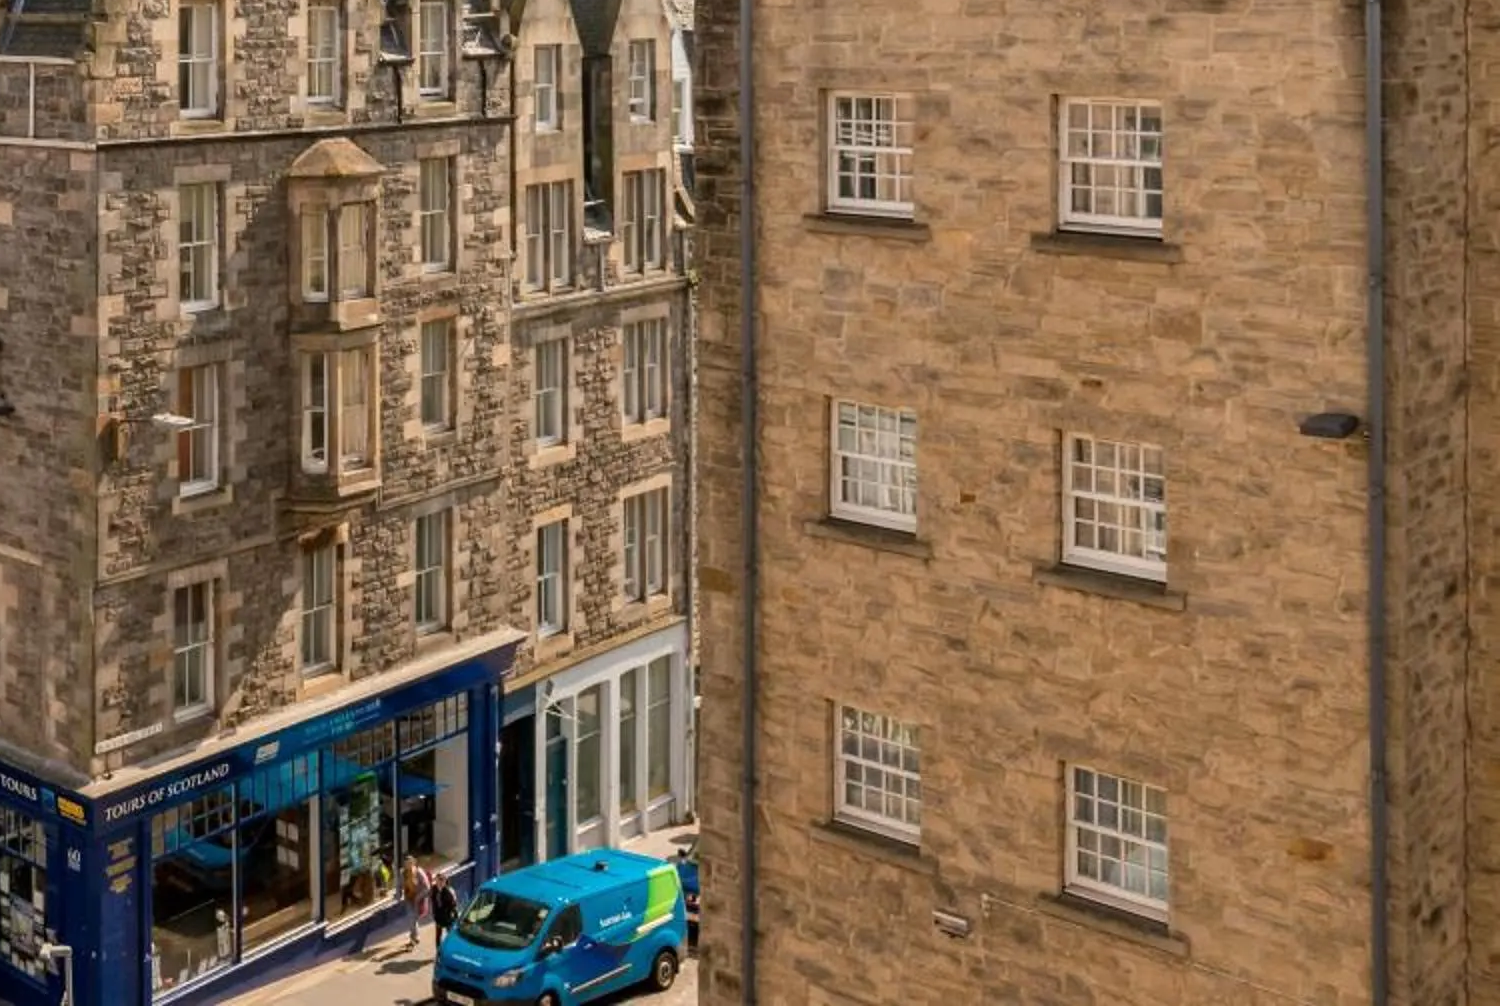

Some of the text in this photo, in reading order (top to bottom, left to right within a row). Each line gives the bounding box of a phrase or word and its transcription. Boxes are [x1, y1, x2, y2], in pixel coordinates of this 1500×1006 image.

[1, 773, 37, 801] TOURS
[104, 793, 147, 822] TOURS
[148, 787, 164, 806] OF
[167, 762, 230, 798] SCOTLAND
